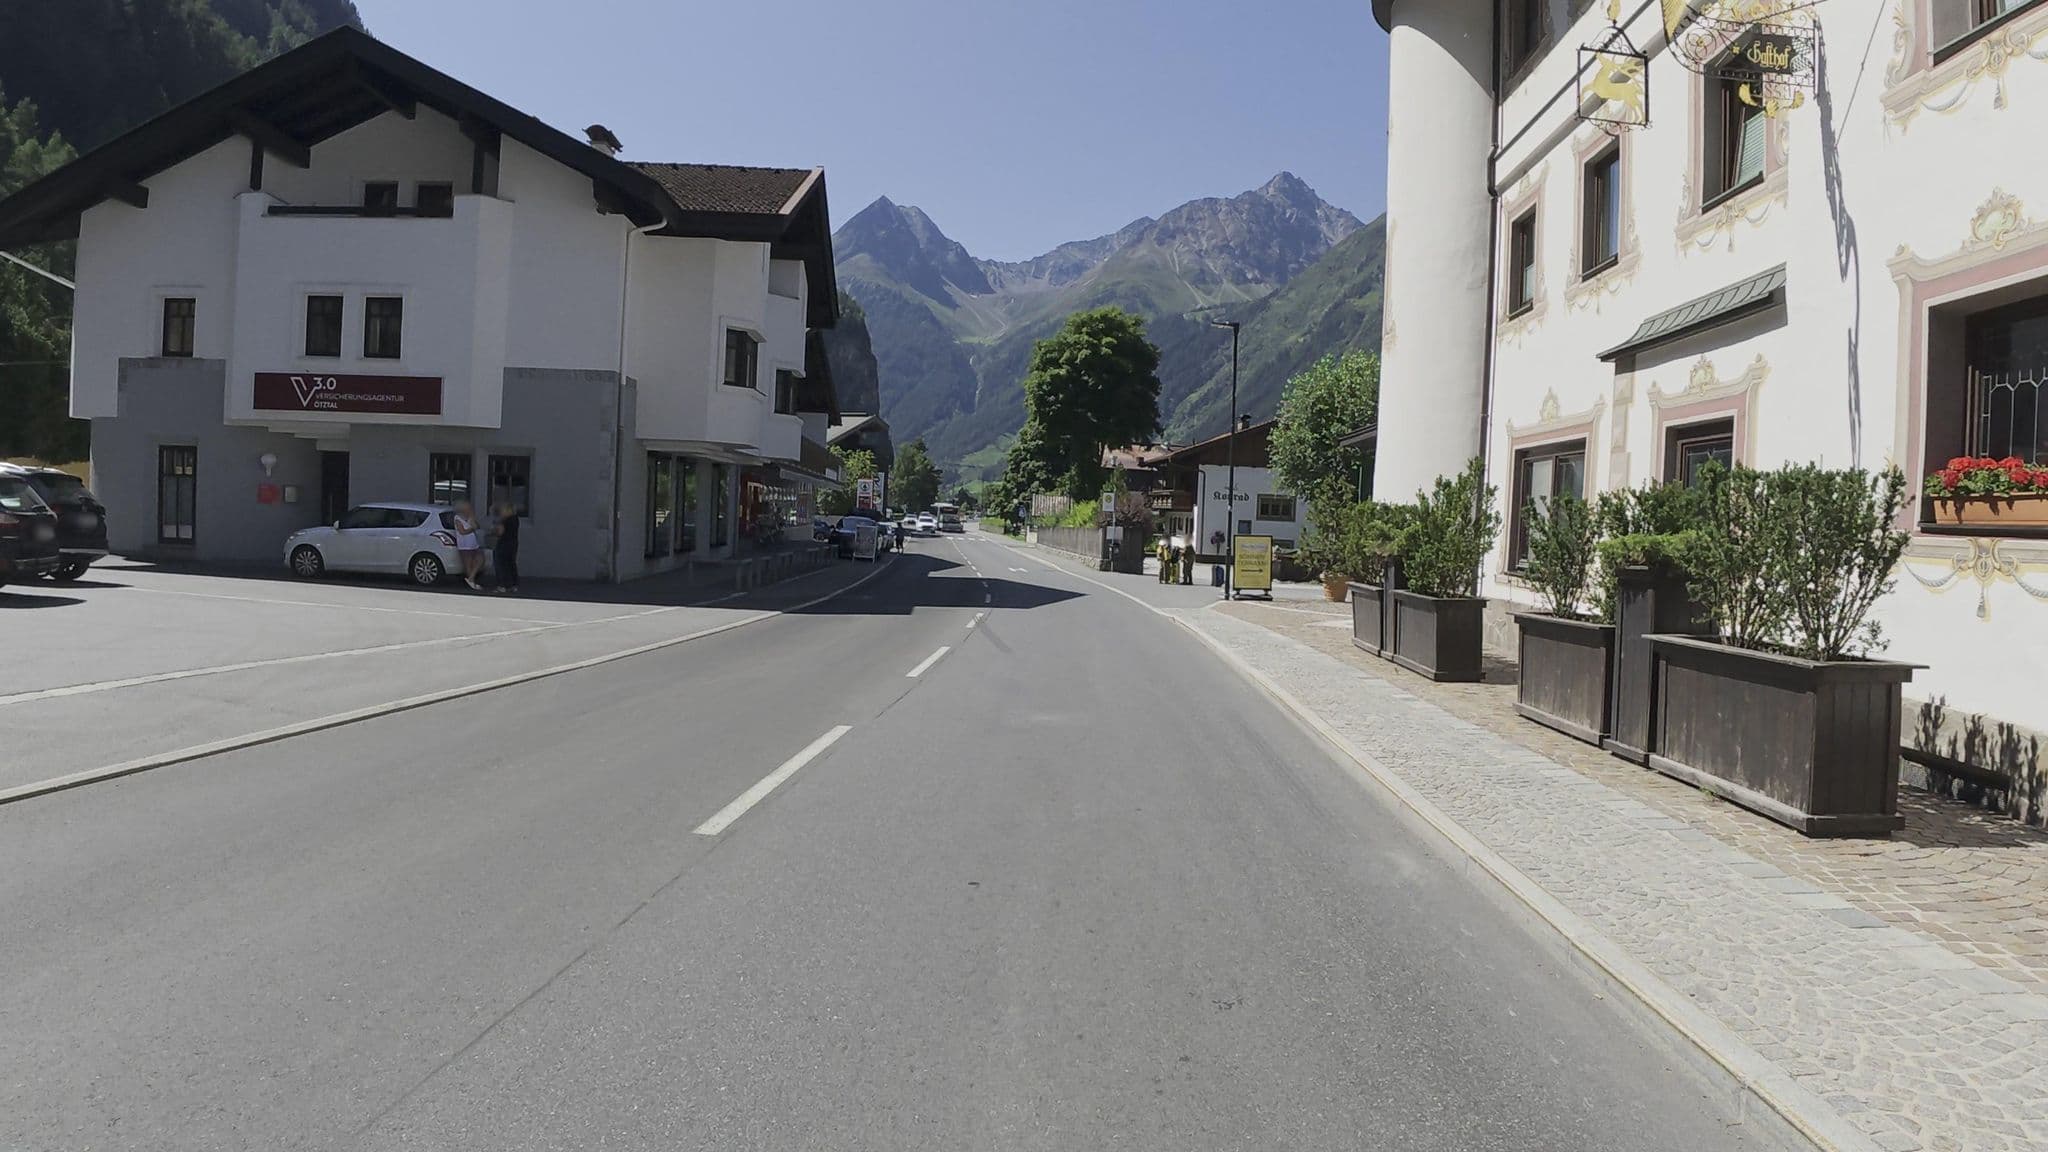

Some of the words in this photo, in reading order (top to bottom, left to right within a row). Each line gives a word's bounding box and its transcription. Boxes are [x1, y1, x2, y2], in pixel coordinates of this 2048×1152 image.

[1747, 40, 1791, 70] Gasthof
[315, 392, 405, 402] VERSICHERUNGSAGENTUR
[1213, 491, 1250, 501] Korad
